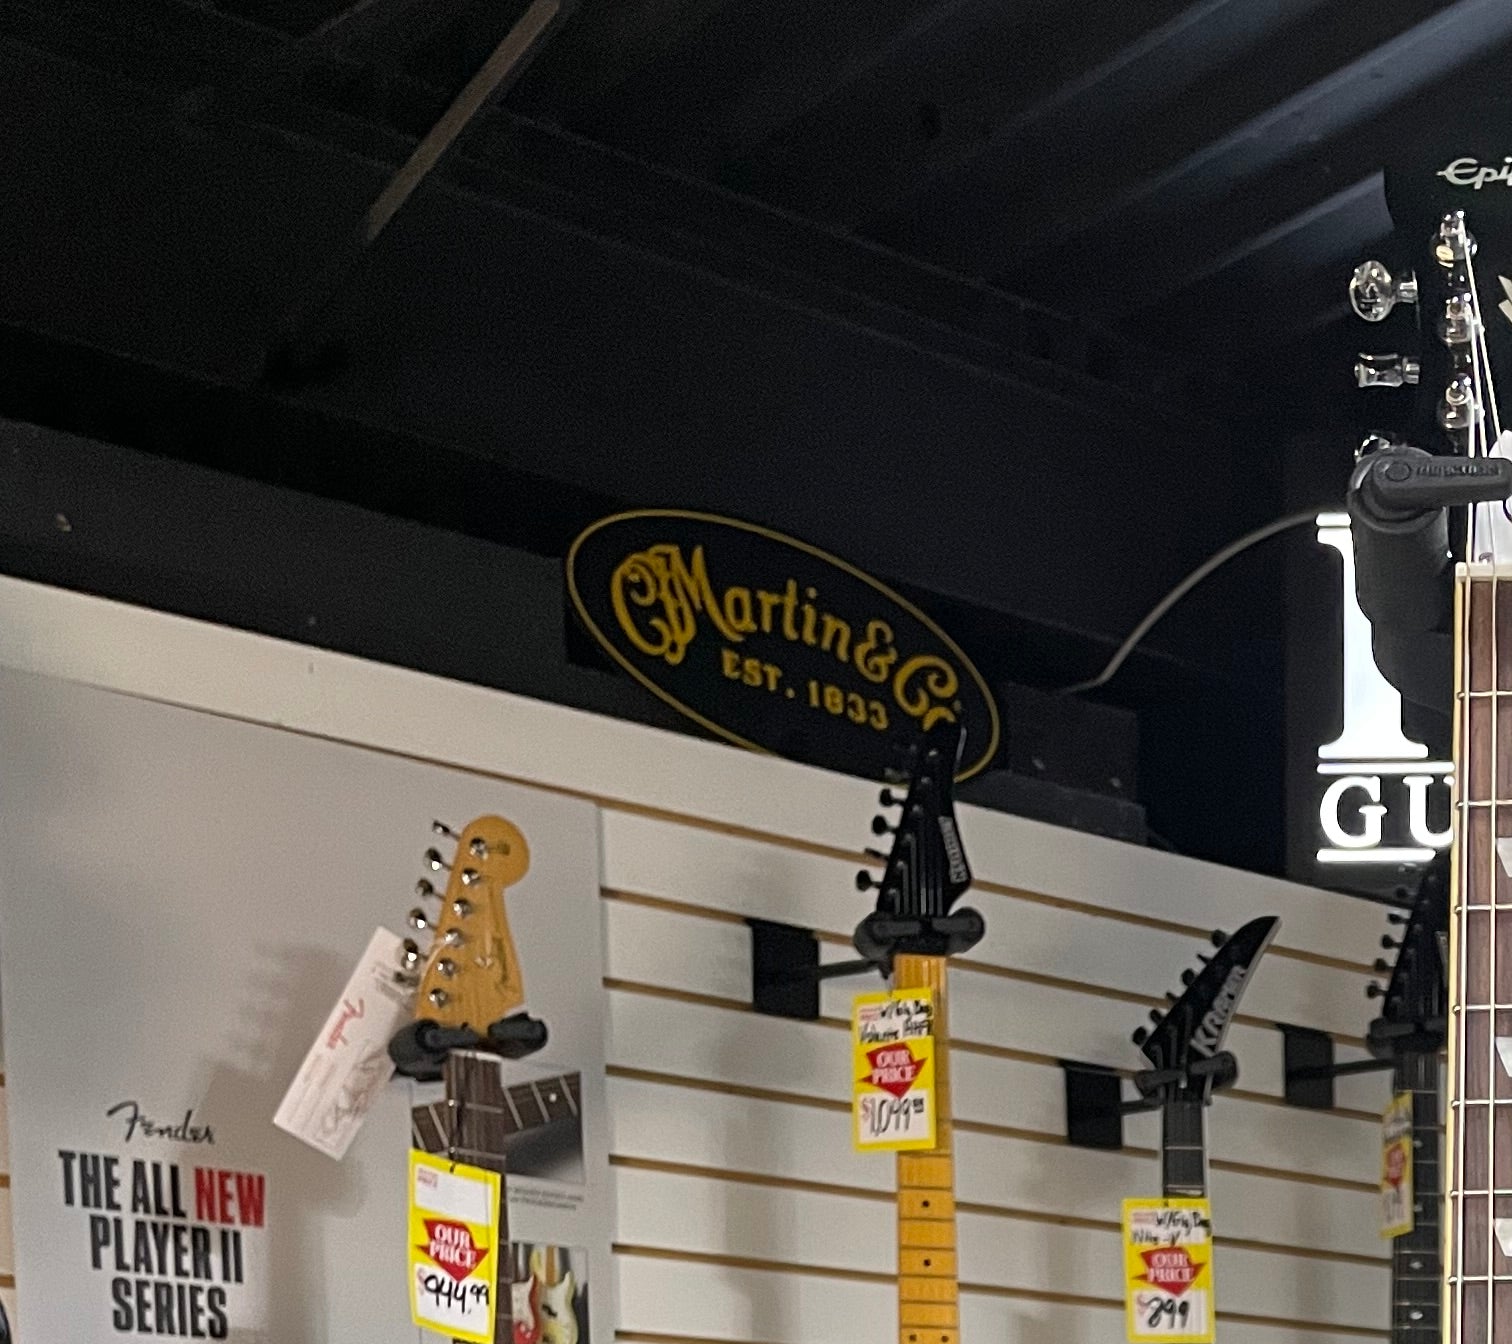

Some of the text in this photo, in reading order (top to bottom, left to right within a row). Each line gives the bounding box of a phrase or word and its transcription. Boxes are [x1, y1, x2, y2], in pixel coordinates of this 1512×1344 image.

[721, 648, 888, 730] EST. 1833
[106, 1100, 216, 1144] Fender
[58, 1149, 266, 1228] THE ALL NEW
[89, 1213, 244, 1284] PLAYER II
[429, 1240, 477, 1269] PRICE
[434, 1223, 471, 1248] OUR
[1147, 1267, 1194, 1283] PRICE
[1151, 1253, 1189, 1268] OUR
[111, 1276, 228, 1341] SERIES
